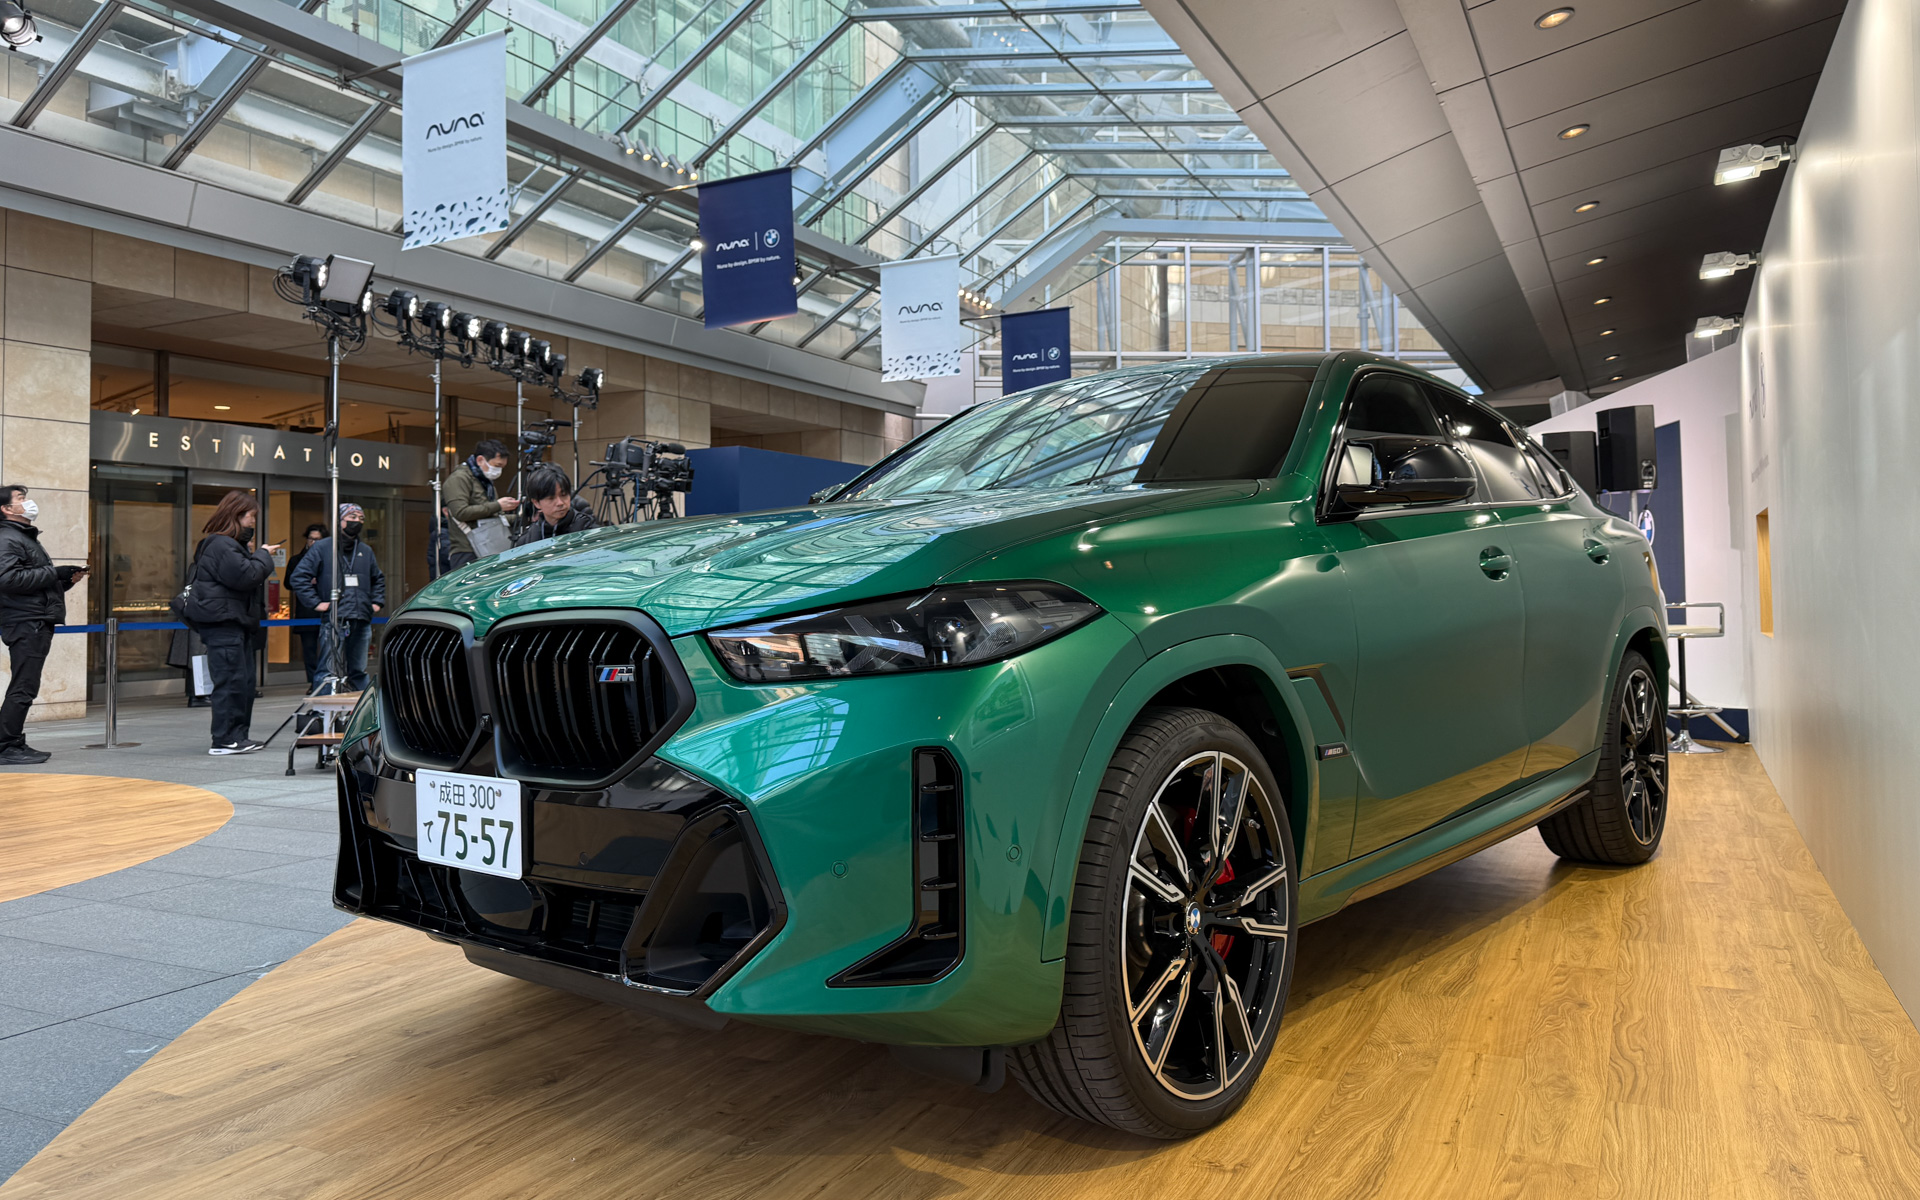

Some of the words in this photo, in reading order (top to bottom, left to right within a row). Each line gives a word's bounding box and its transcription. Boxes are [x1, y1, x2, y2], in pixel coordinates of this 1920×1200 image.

[426, 113, 484, 140] nuna
[716, 239, 750, 252] nuna
[898, 302, 943, 316] nuna
[1012, 352, 1038, 361] nuna
[439, 781, 465, 806] 成田
[469, 784, 496, 810] 300
[423, 820, 434, 843] て
[437, 810, 514, 869] 75-57
